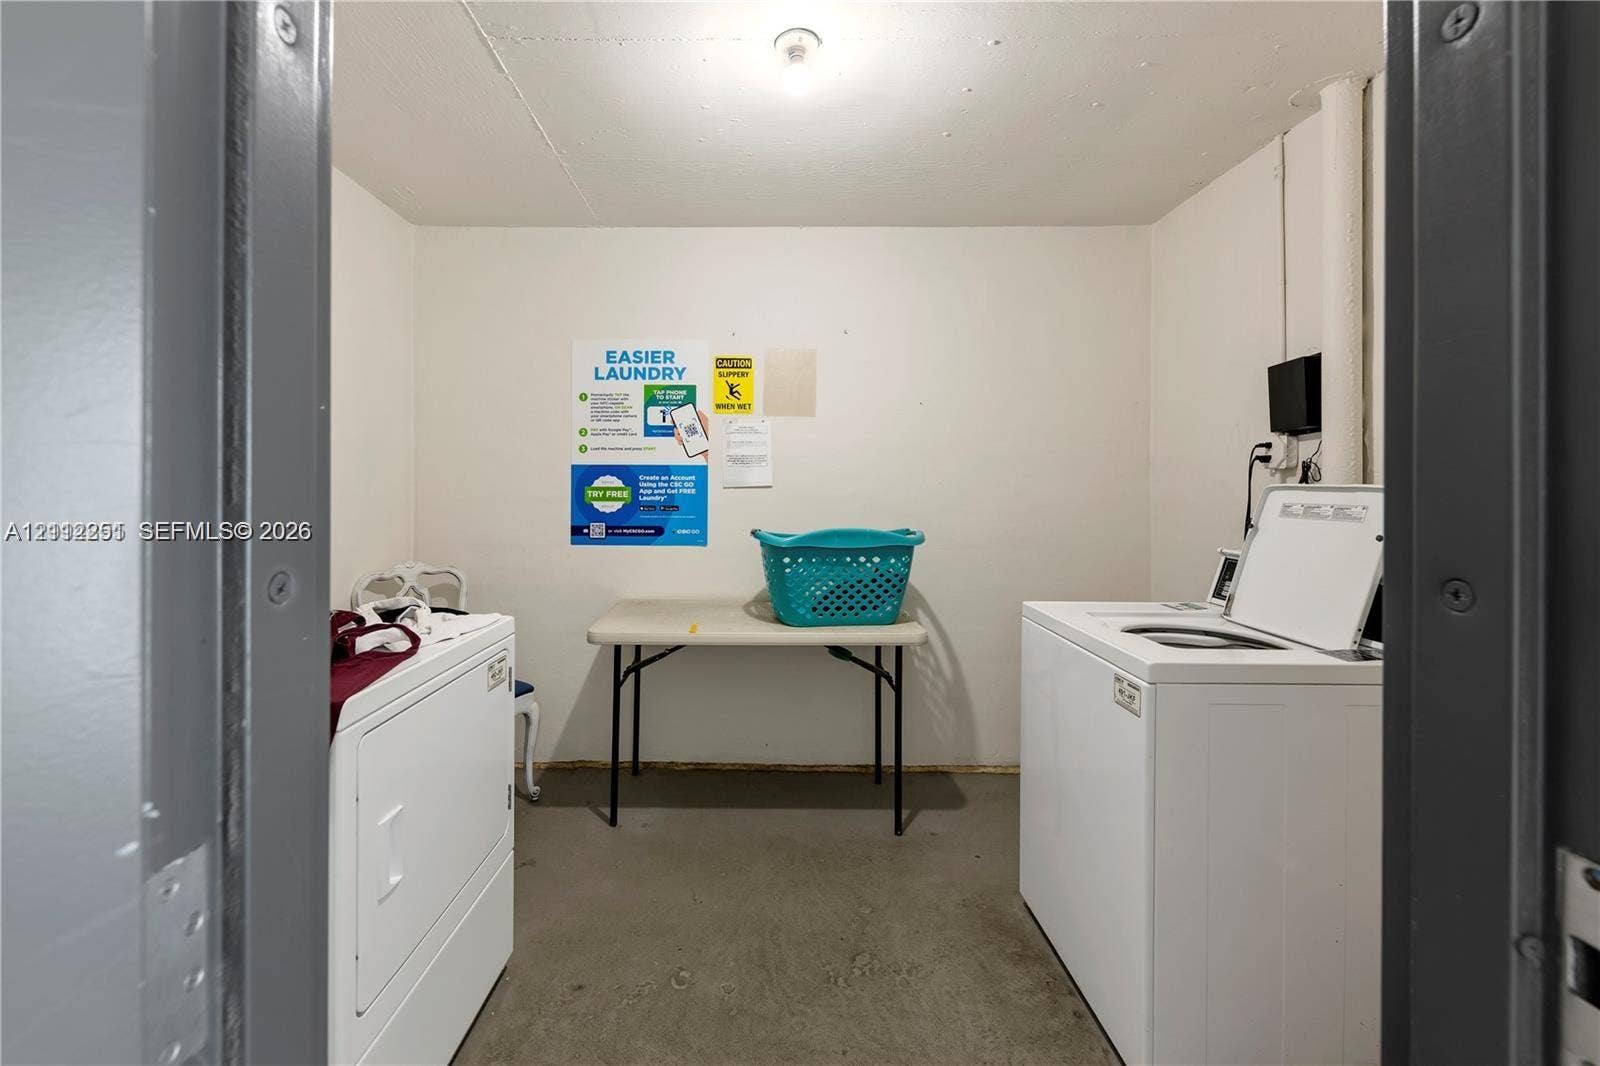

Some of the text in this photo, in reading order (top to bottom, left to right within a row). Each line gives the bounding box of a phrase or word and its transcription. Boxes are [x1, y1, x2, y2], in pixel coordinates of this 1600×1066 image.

[605, 350, 676, 364] EASIER
[716, 359, 751, 368] CAUTION
[594, 366, 687, 380] LAUNDRY
